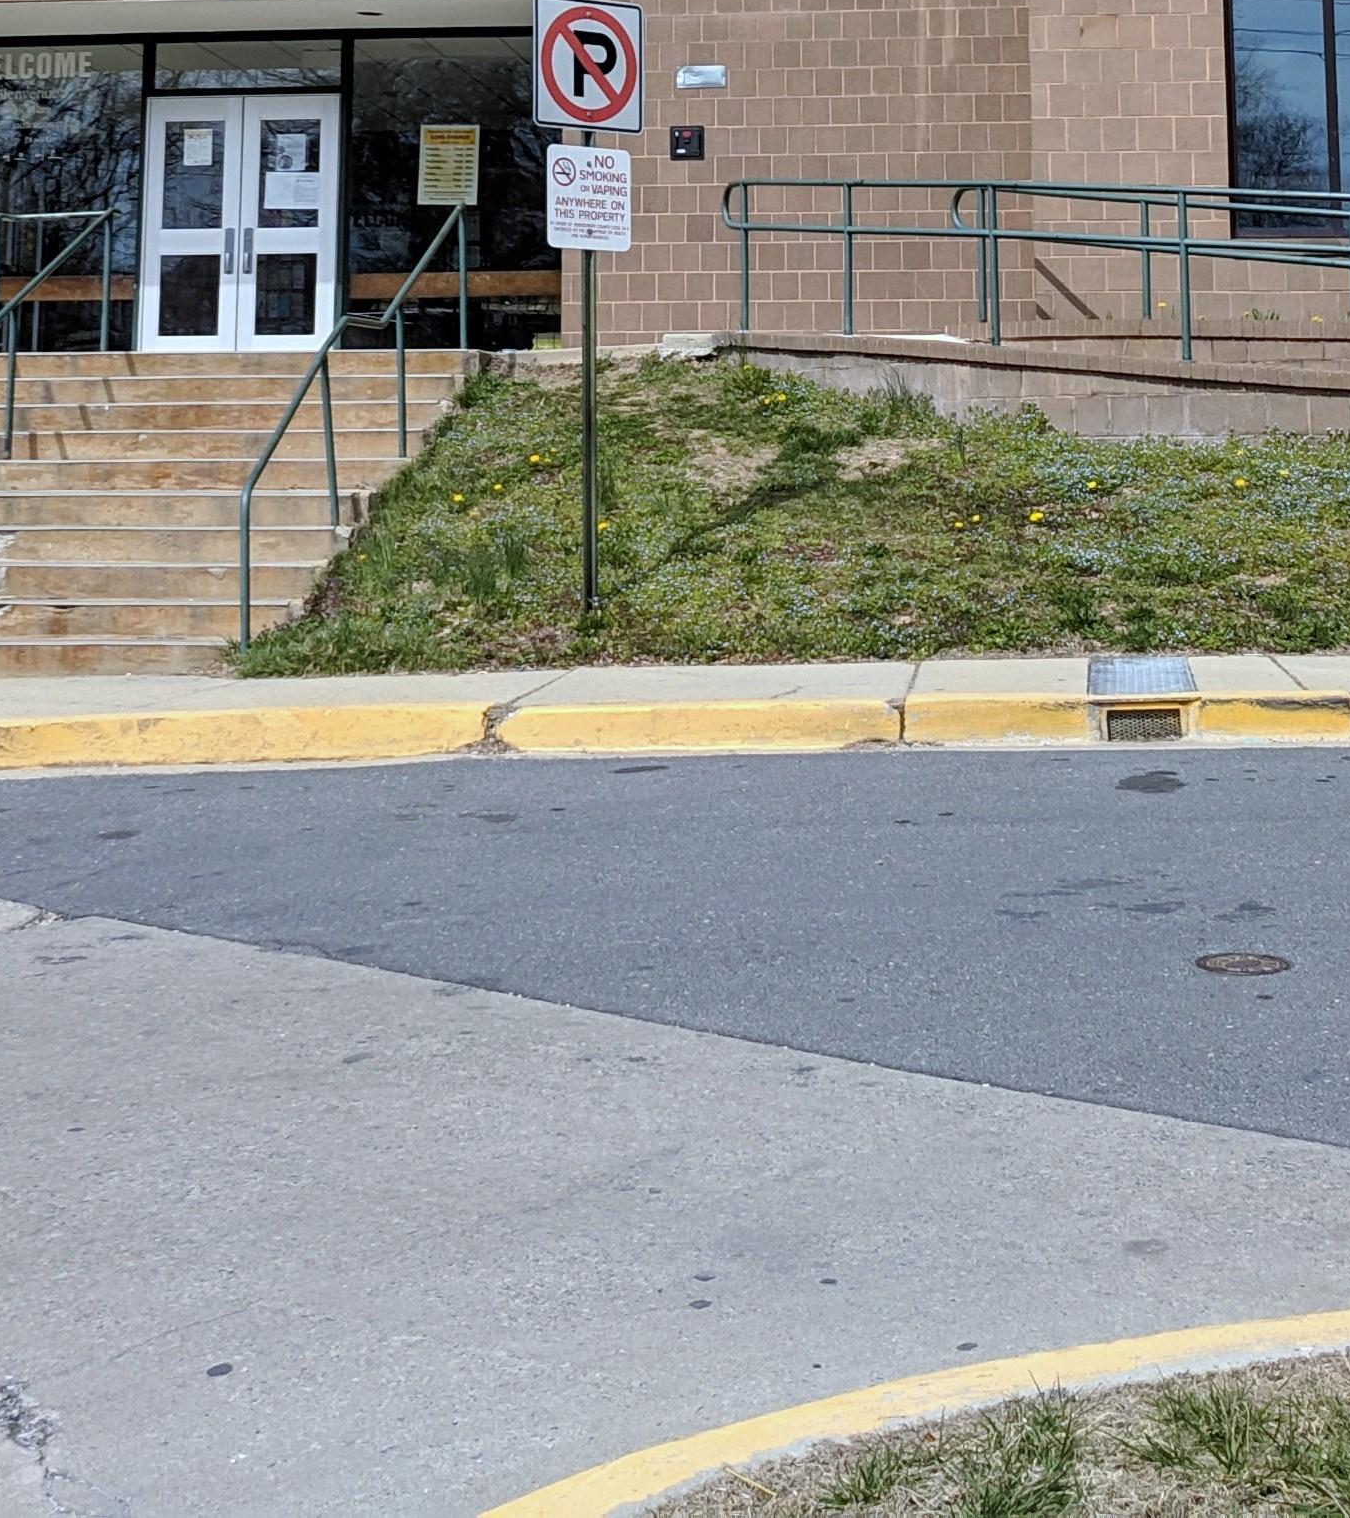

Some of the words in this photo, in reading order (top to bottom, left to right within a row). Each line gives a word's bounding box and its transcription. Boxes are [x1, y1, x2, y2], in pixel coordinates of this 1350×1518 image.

[573, 30, 617, 97] P
[594, 155, 614, 169] NO
[579, 170, 627, 183] SMOKING
[591, 184, 627, 197] VAPING
[555, 196, 607, 209] ANYWHERE
[610, 201, 625, 210] ON
[554, 208, 575, 219] THIS
[578, 210, 625, 222] PROPERTY
